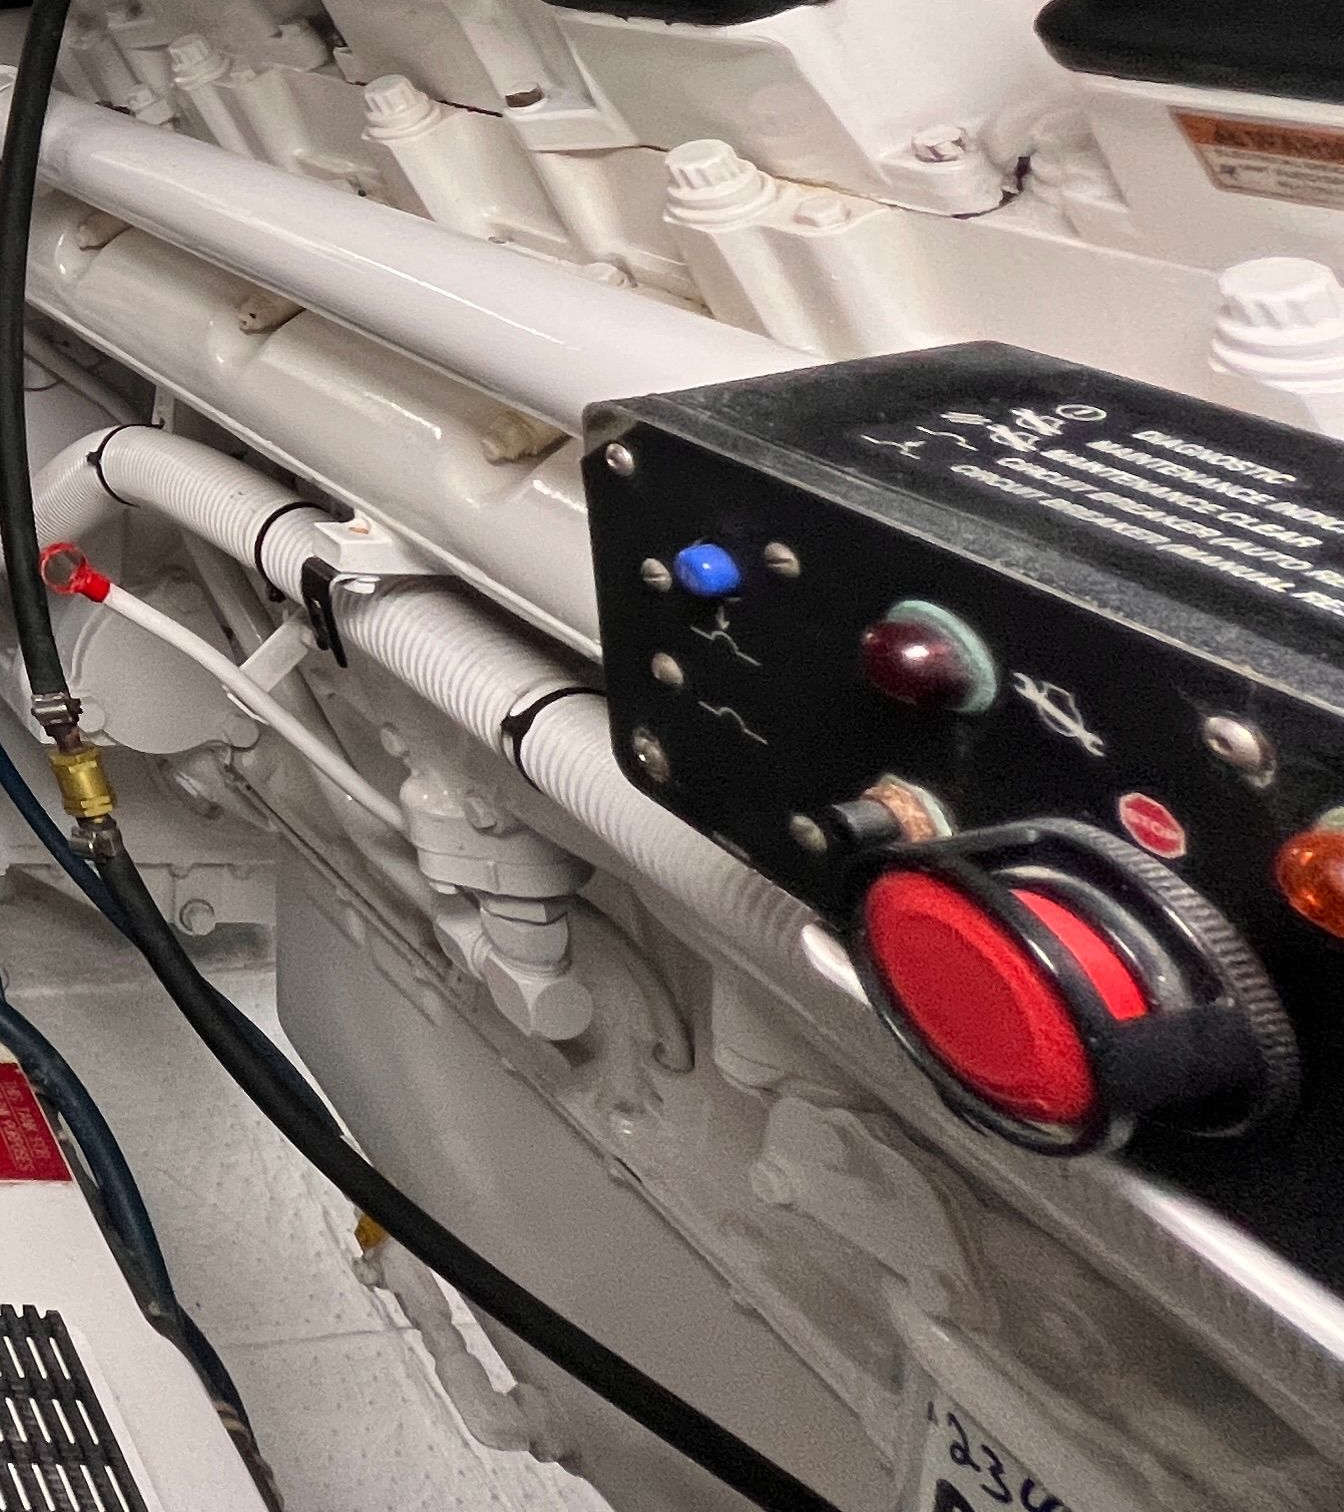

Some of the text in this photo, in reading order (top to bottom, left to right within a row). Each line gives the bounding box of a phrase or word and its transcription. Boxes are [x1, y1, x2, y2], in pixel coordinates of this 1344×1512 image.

[1086, 440, 1281, 505] MAINTENANCE
[1131, 431, 1297, 484] DIAGNOSTIC
[951, 465, 1053, 499] CIRCUIT
[1037, 498, 1171, 545] BREAKER
[996, 458, 1100, 492] CIRCUIT
[1085, 492, 1223, 539] BREAKER
[1037, 449, 1323, 547] MAINTENANCE CLEAR
